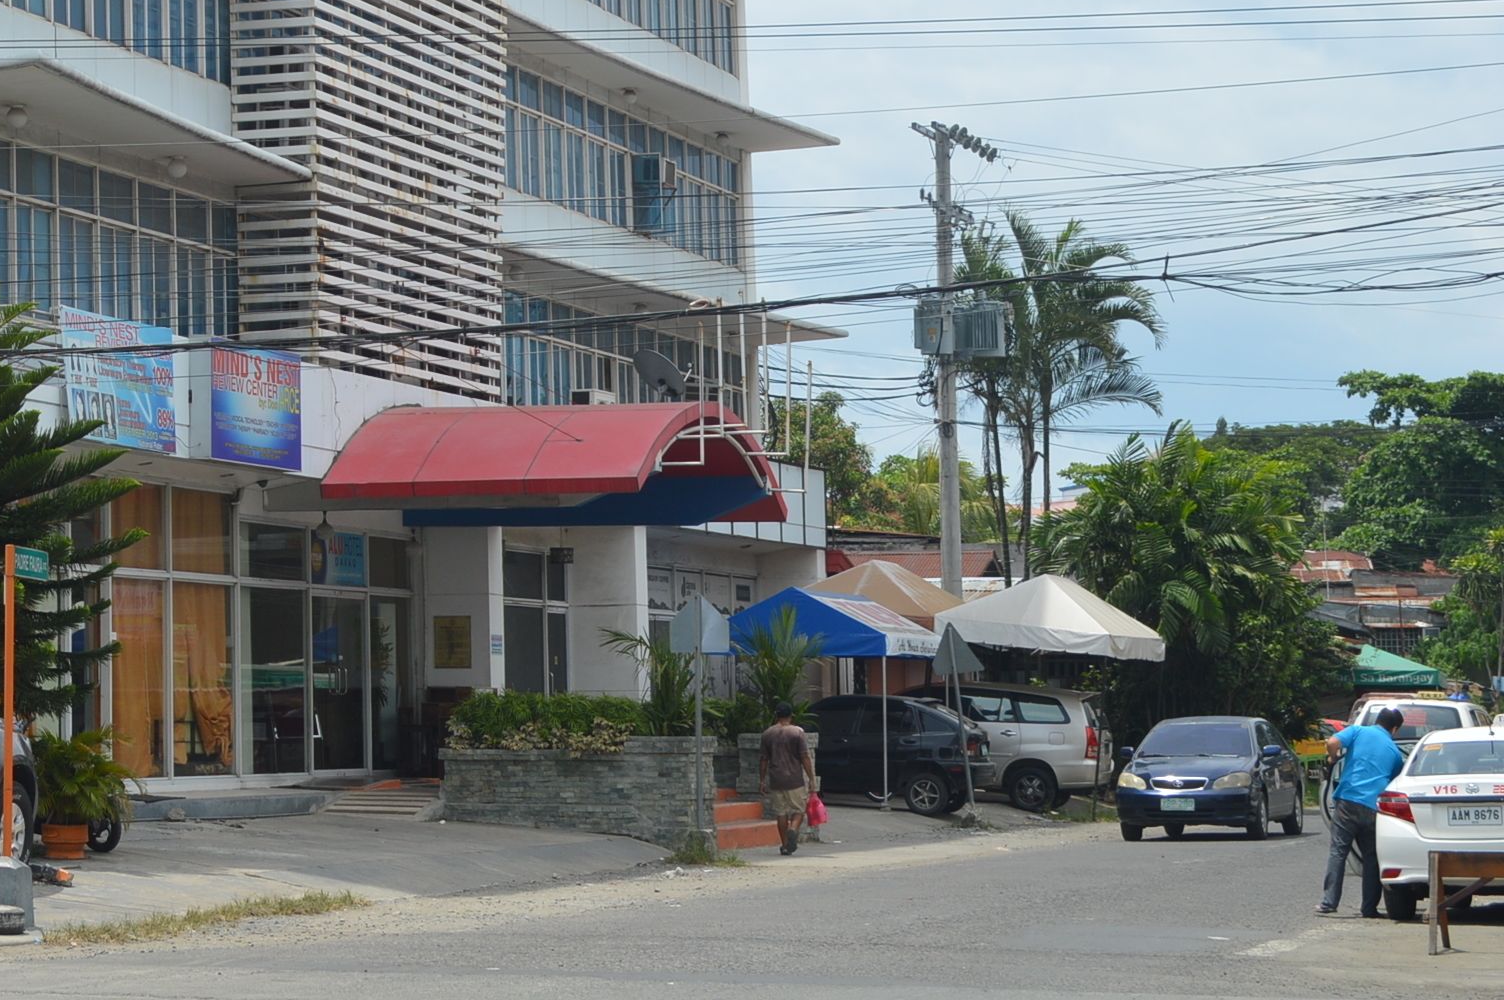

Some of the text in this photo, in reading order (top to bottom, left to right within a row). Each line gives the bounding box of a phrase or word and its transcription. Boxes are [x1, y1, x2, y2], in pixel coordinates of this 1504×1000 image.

[64, 311, 141, 342] MIND'S NEST
[213, 347, 301, 388] MIND'S NEST
[213, 373, 278, 399] REVIEW CENTER
[1433, 785, 1458, 795] V16
[1451, 809, 1470, 820] AAM
